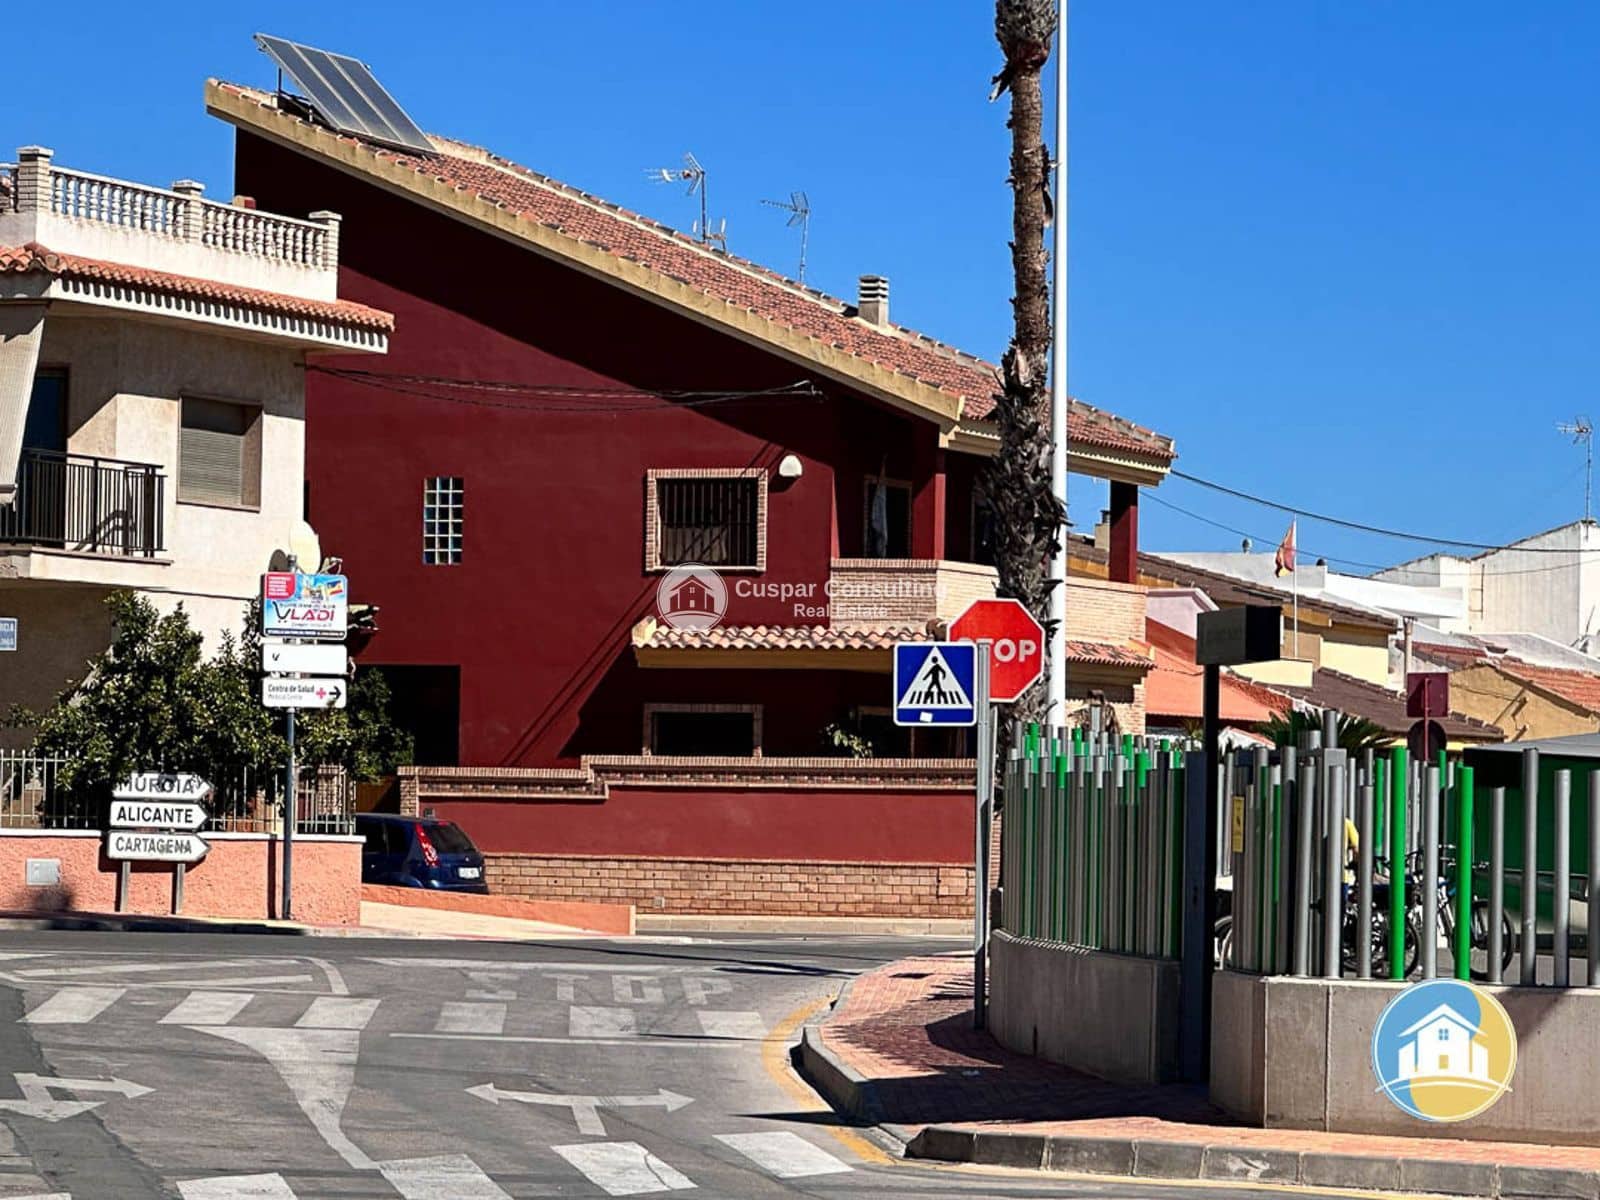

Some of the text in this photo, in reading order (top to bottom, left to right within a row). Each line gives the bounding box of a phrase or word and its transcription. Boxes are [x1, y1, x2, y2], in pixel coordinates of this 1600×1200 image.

[958, 637, 1037, 663] TOP
[116, 806, 193, 823] ALICANTE
[115, 836, 192, 854] CARTAGENA
[464, 971, 734, 1005] STOP
